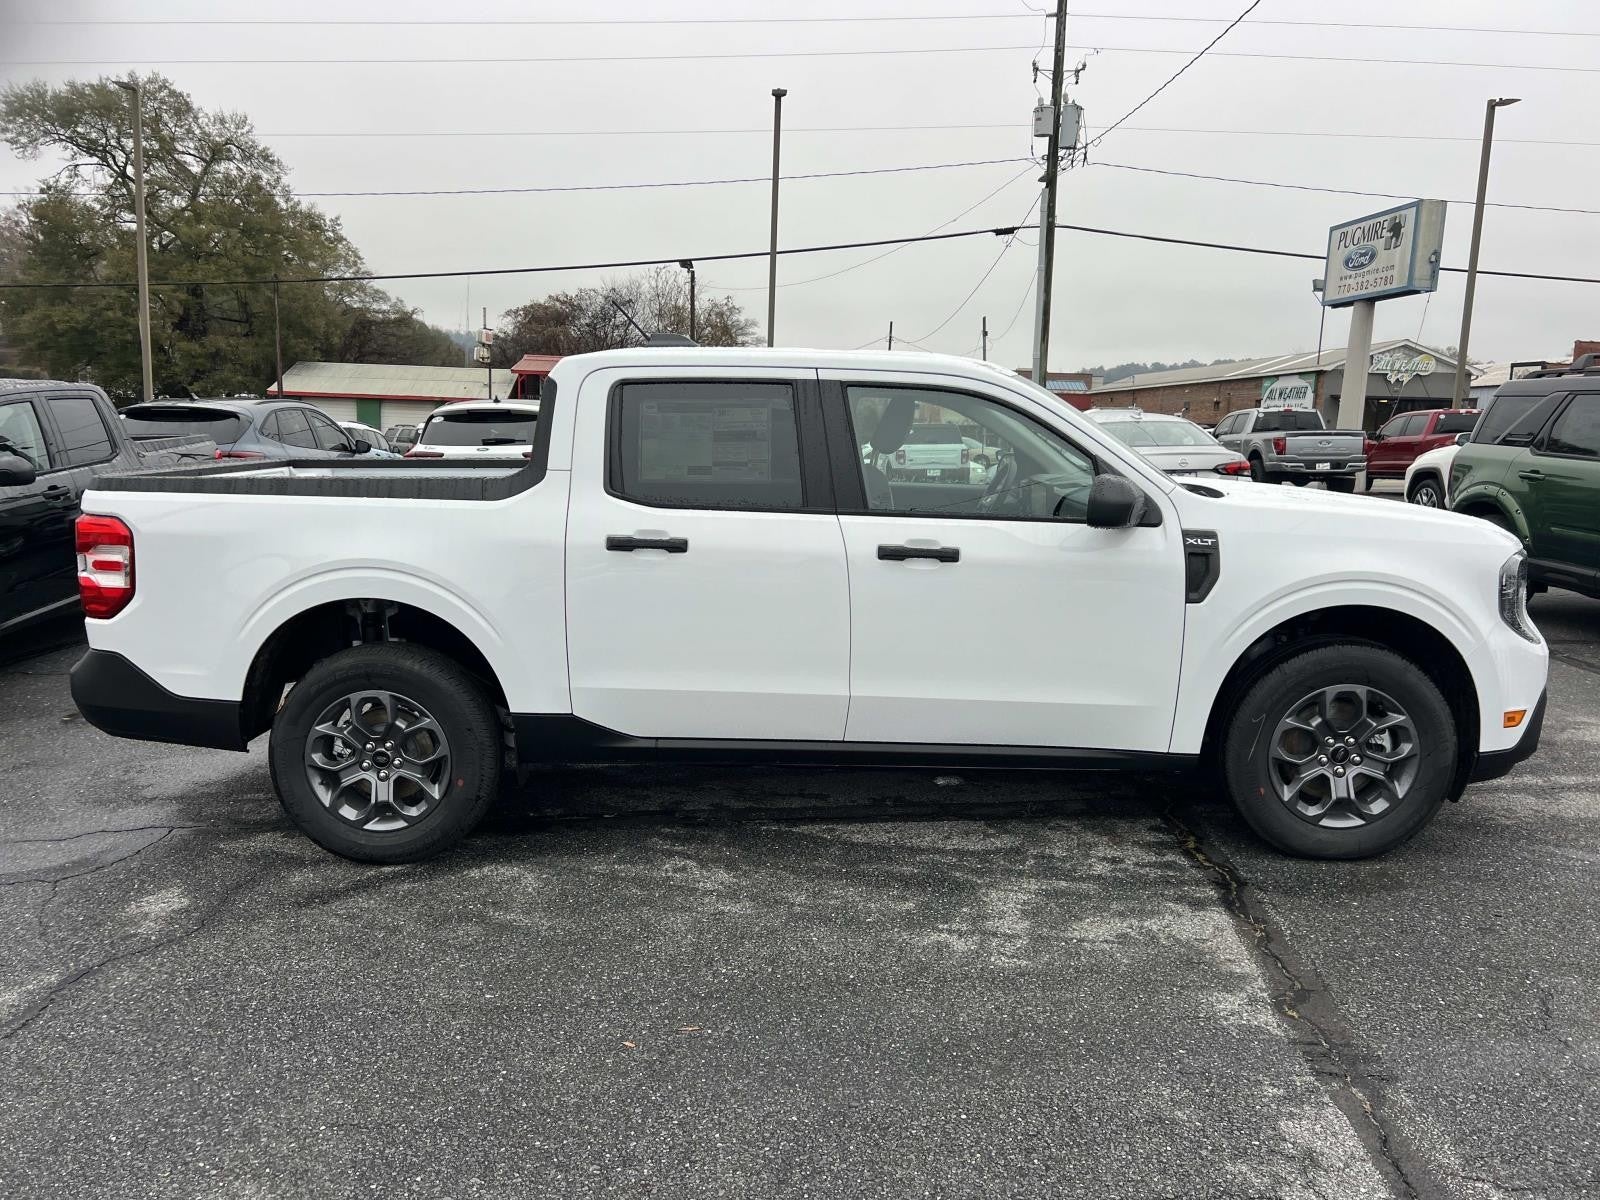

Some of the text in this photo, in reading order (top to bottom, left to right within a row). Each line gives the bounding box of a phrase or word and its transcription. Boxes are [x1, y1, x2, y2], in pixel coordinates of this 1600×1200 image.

[1337, 219, 1388, 250] PUGMIRE
[1348, 250, 1371, 268] Ford
[1340, 264, 1395, 281] www.pugmire.com
[1337, 274, 1394, 295] 770-382-5780
[1393, 359, 1434, 371] WEATHER
[1266, 386, 1308, 401] ALL WEATHER
